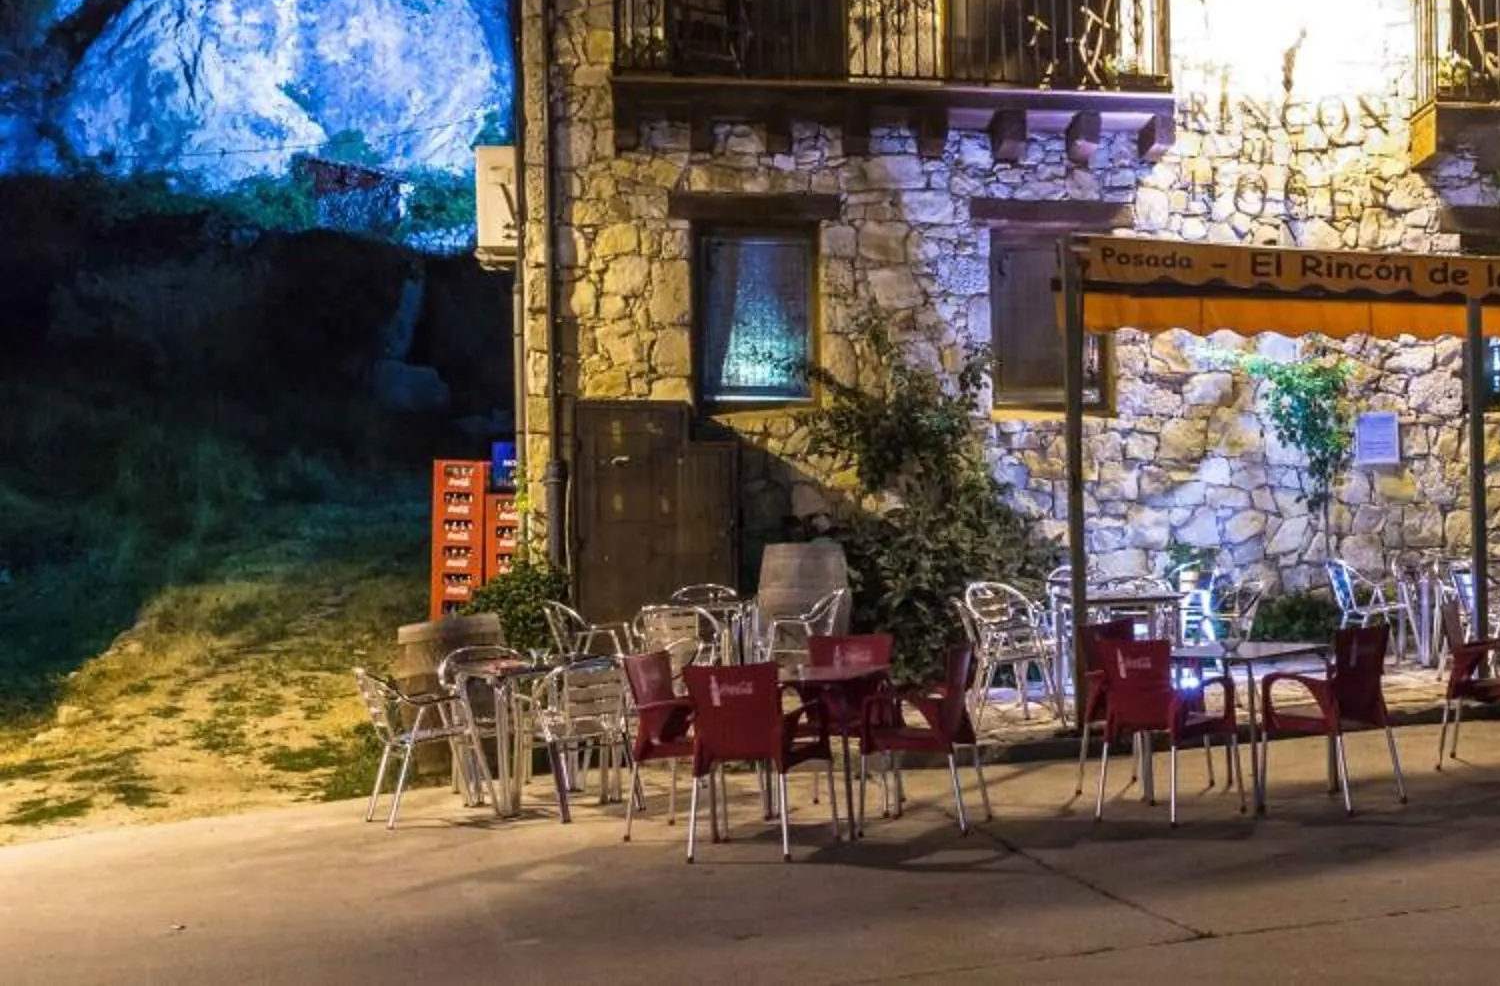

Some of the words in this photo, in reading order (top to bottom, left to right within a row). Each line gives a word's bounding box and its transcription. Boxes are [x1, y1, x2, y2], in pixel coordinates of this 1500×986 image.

[1101, 247, 1193, 269] Posada
[1251, 252, 1282, 277] El
[1301, 254, 1412, 282] Rincón
[1428, 262, 1469, 285] de
